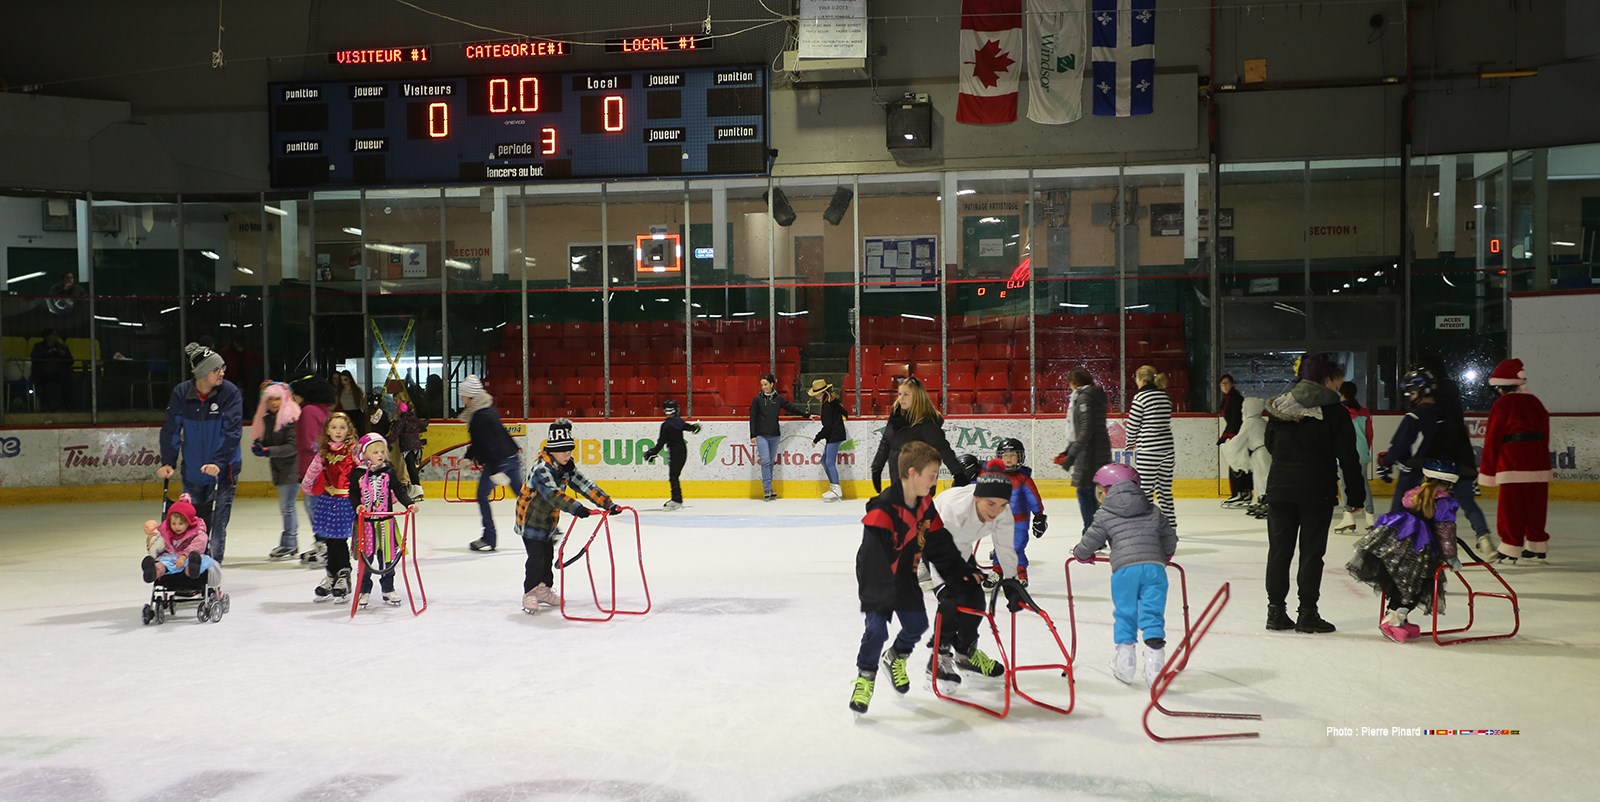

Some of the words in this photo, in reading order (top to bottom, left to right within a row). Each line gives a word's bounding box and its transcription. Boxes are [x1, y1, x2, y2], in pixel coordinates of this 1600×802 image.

[623, 37, 668, 51] LOCAL
[679, 36, 695, 49] #1
[336, 50, 402, 63] VISITEUR
[411, 49, 427, 61] #1
[1040, 34, 1055, 92] Windsor
[587, 77, 618, 89] Local
[649, 73, 680, 87] joueur
[717, 72, 753, 83] punition
[285, 88, 319, 100] punition
[354, 86, 384, 98] joueur
[403, 84, 452, 97] Visiteurs
[489, 78, 539, 113] 0.0
[429, 102, 448, 137] 0
[604, 95, 623, 131] 0
[649, 129, 680, 142] joueur
[718, 127, 753, 139] punition
[286, 142, 319, 153] punition
[355, 139, 384, 152] joueur
[542, 128, 556, 154] 3
[498, 143, 532, 156] periode
[486, 166, 517, 178] lancers
[518, 168, 529, 177] au
[530, 165, 544, 176] but
[1308, 226, 1350, 236] SECTION
[454, 248, 490, 257] SECTION
[64, 445, 100, 468] Tim
[102, 444, 162, 467] Horton
